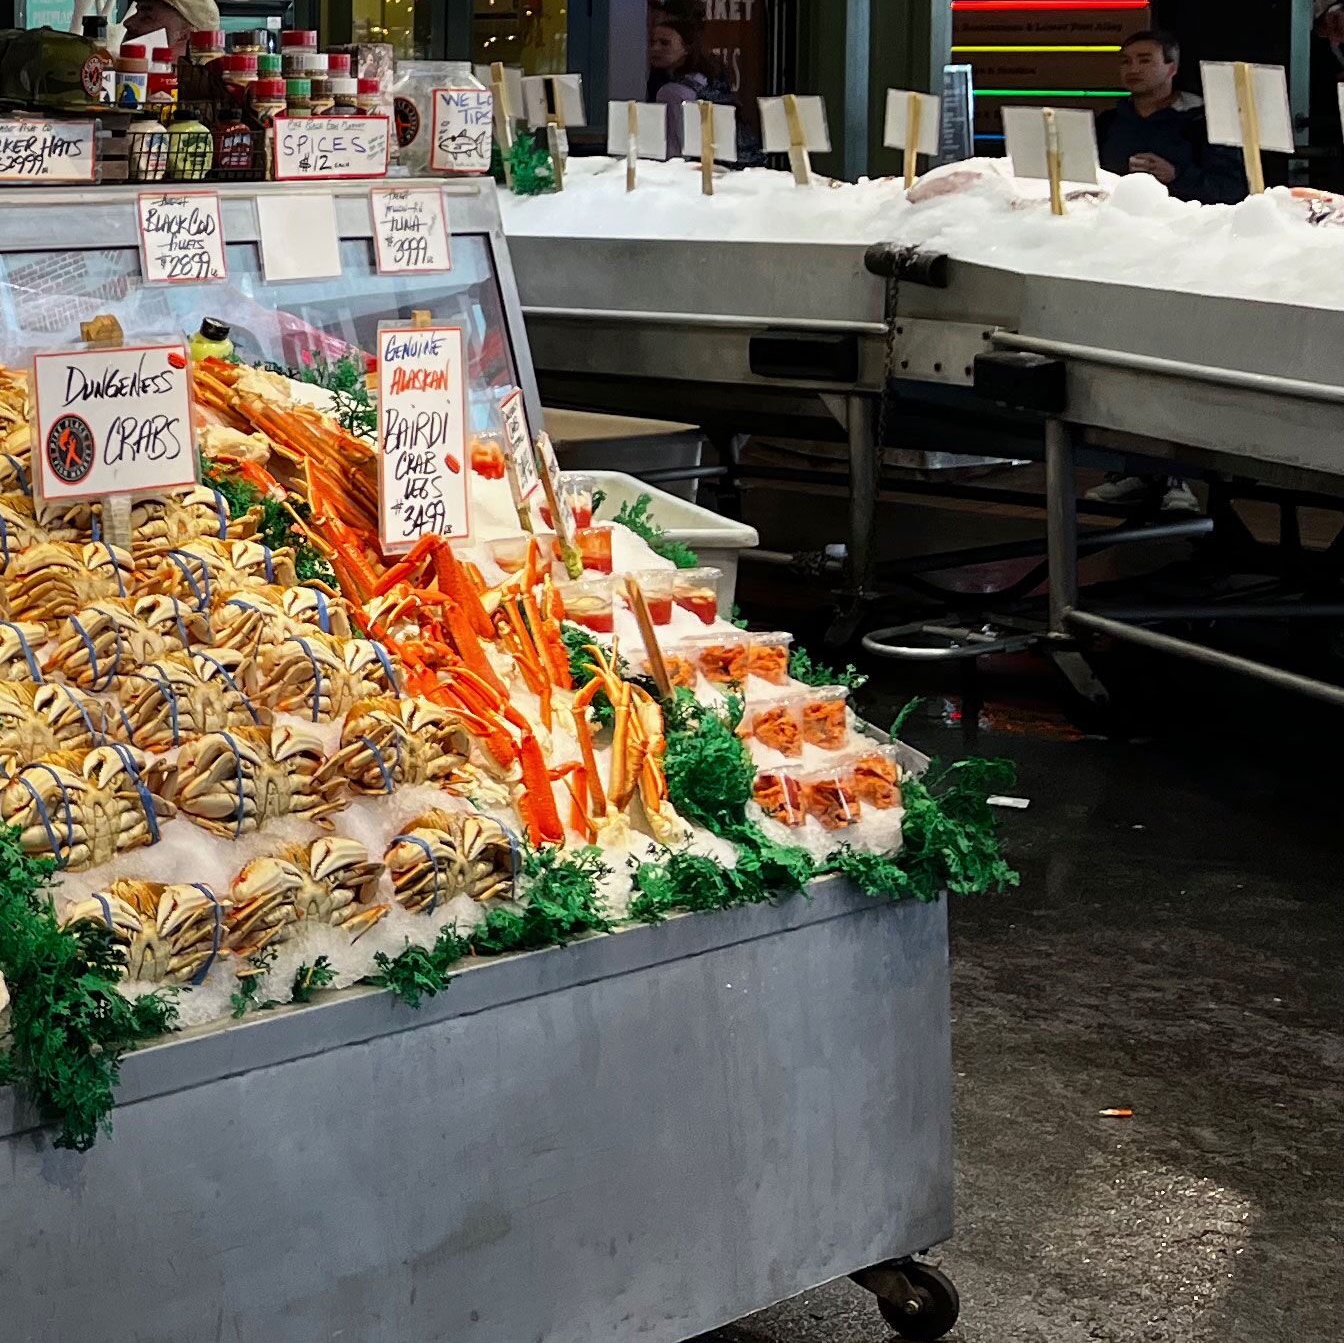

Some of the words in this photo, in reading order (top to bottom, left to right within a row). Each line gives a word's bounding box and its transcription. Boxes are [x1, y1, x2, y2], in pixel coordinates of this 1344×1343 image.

[441, 92, 470, 107] WE
[40, 135, 84, 158] HATS
[283, 134, 367, 156] SPICES
[298, 152, 332, 172] $12
[143, 208, 188, 234] BLACK
[188, 208, 216, 236] COD
[379, 215, 429, 233] TUNA
[65, 361, 174, 408] DUNGENESS
[389, 364, 450, 394] ALASKAN
[102, 414, 181, 467] CRABS
[395, 449, 437, 476] CRAB
[403, 473, 443, 501] LEGS
